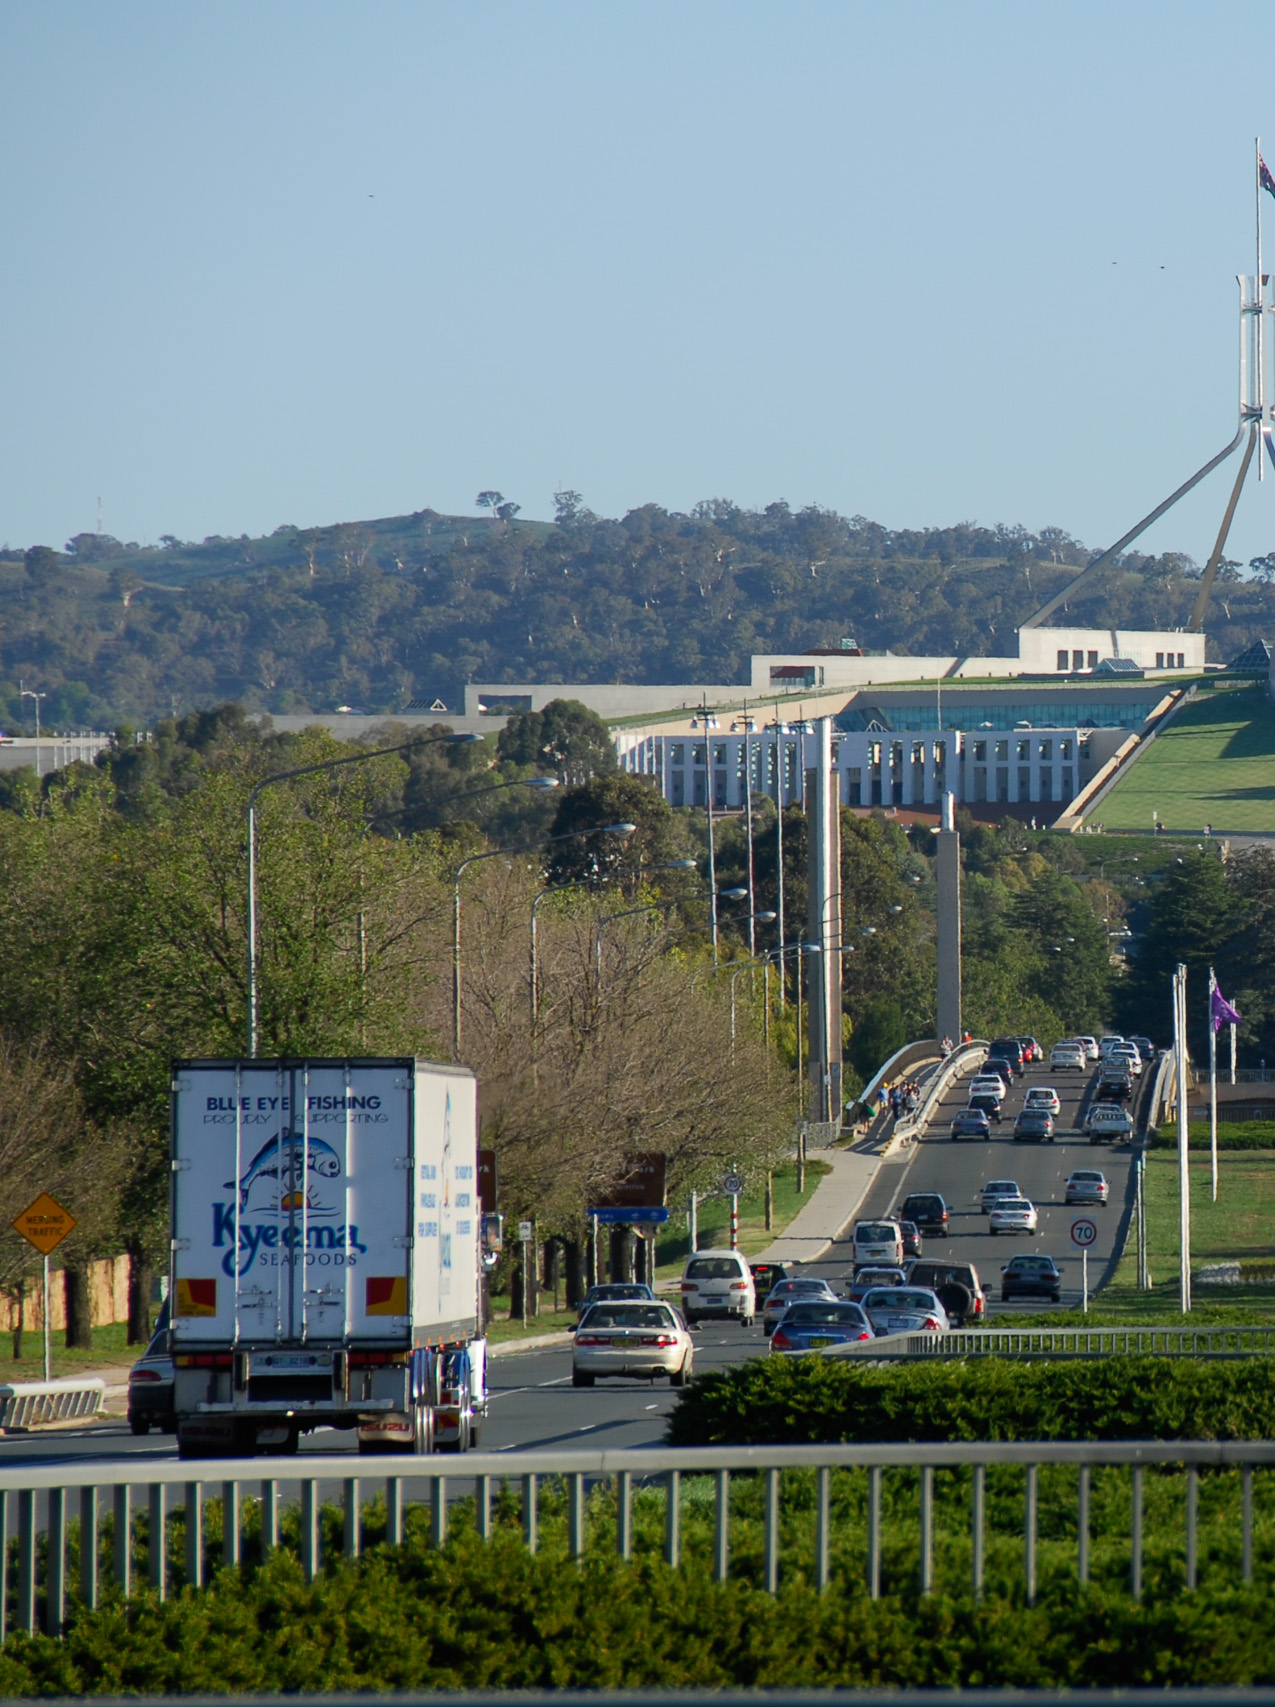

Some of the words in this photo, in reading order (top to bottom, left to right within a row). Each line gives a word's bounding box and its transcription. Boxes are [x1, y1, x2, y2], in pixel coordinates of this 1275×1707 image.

[206, 1097, 251, 1111] BLUE
[257, 1097, 291, 1111] EYE
[307, 1095, 382, 1110] FISHING
[203, 1114, 272, 1124] PROUDLY
[294, 1112, 389, 1124] SUPPORTING
[28, 1227, 63, 1236] TRAFFIC
[1075, 1226, 1093, 1239] 70
[211, 1202, 368, 1278] Kyeema
[259, 1253, 357, 1266] SEAFOODS
[361, 1422, 410, 1432] ISUZU
